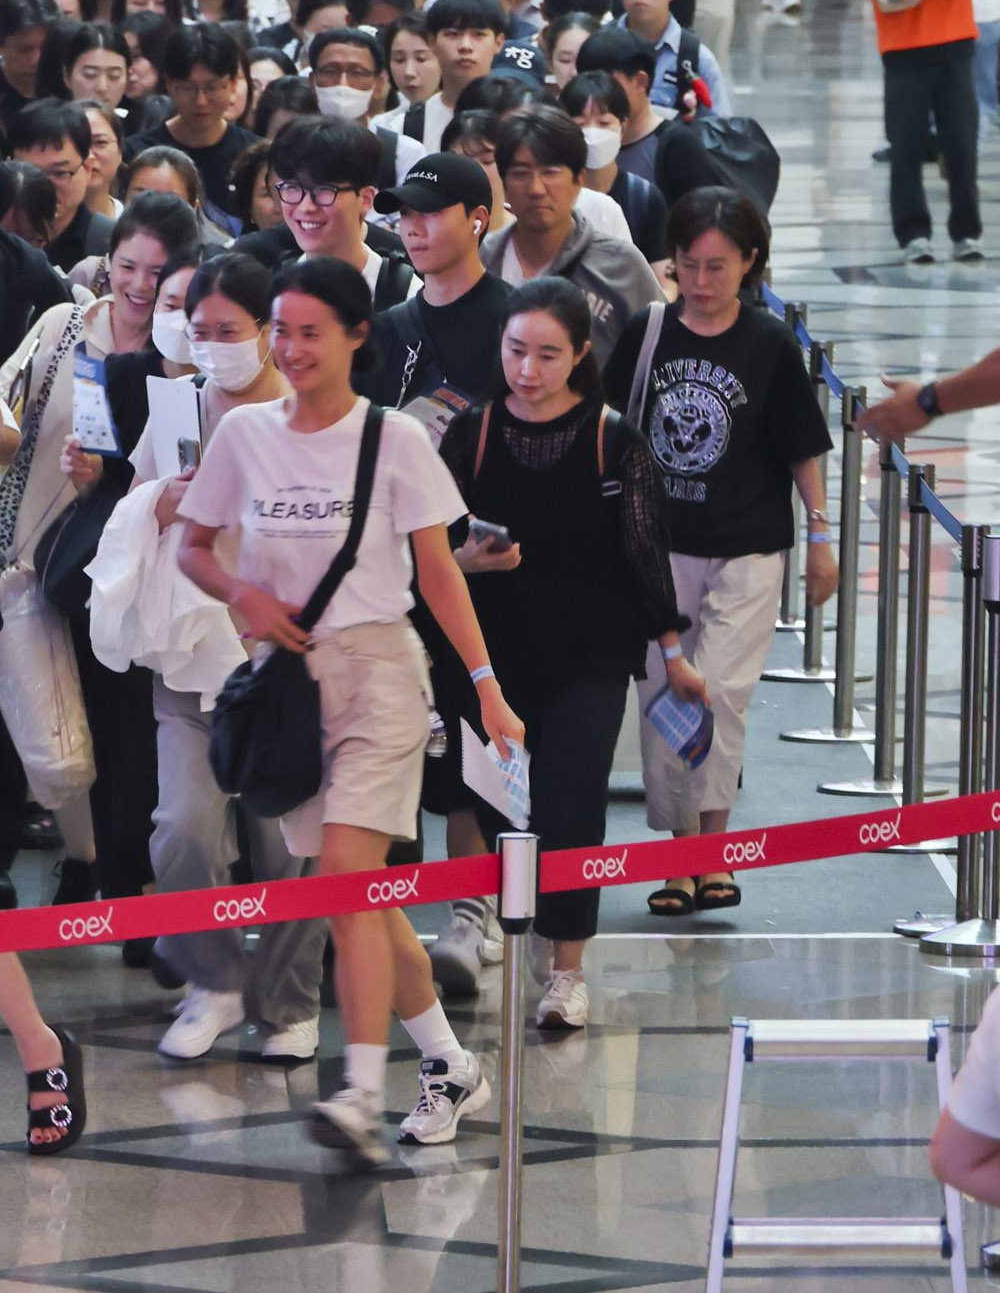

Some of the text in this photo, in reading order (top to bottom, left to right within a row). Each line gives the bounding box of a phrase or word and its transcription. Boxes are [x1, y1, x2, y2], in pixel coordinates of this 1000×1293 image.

[664, 475, 707, 502] ARIS
[59, 906, 114, 941] coex
[213, 888, 267, 922] coex
[367, 870, 419, 904] coex
[583, 849, 628, 880] coex
[724, 833, 767, 864] coex
[859, 813, 901, 844] coex
